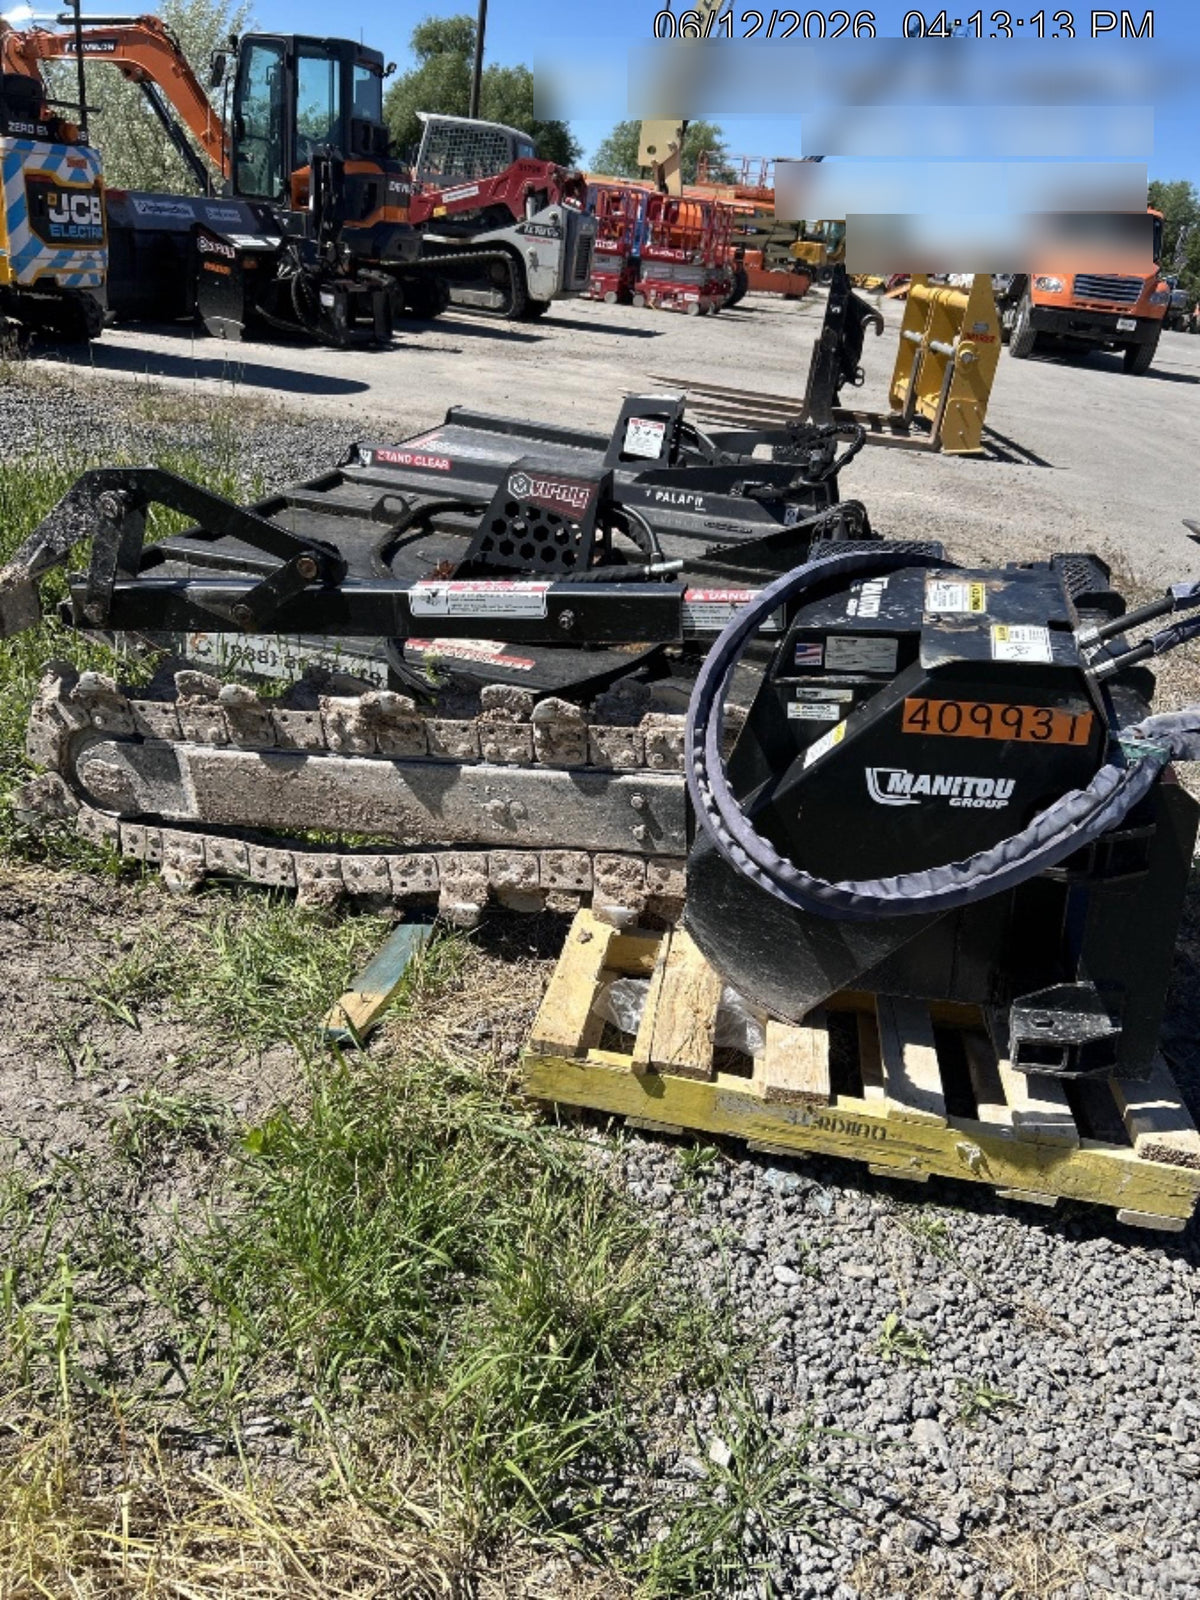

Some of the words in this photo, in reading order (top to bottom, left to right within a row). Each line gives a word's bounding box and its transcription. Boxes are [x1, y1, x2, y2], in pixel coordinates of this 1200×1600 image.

[8, 121, 34, 134] ZERO
[48, 193, 102, 225] JCB
[414, 456, 450, 470] CLEAR
[907, 700, 1077, 742] 409931
[886, 772, 1017, 800] MANITOU
[949, 798, 1009, 810] GROUP
